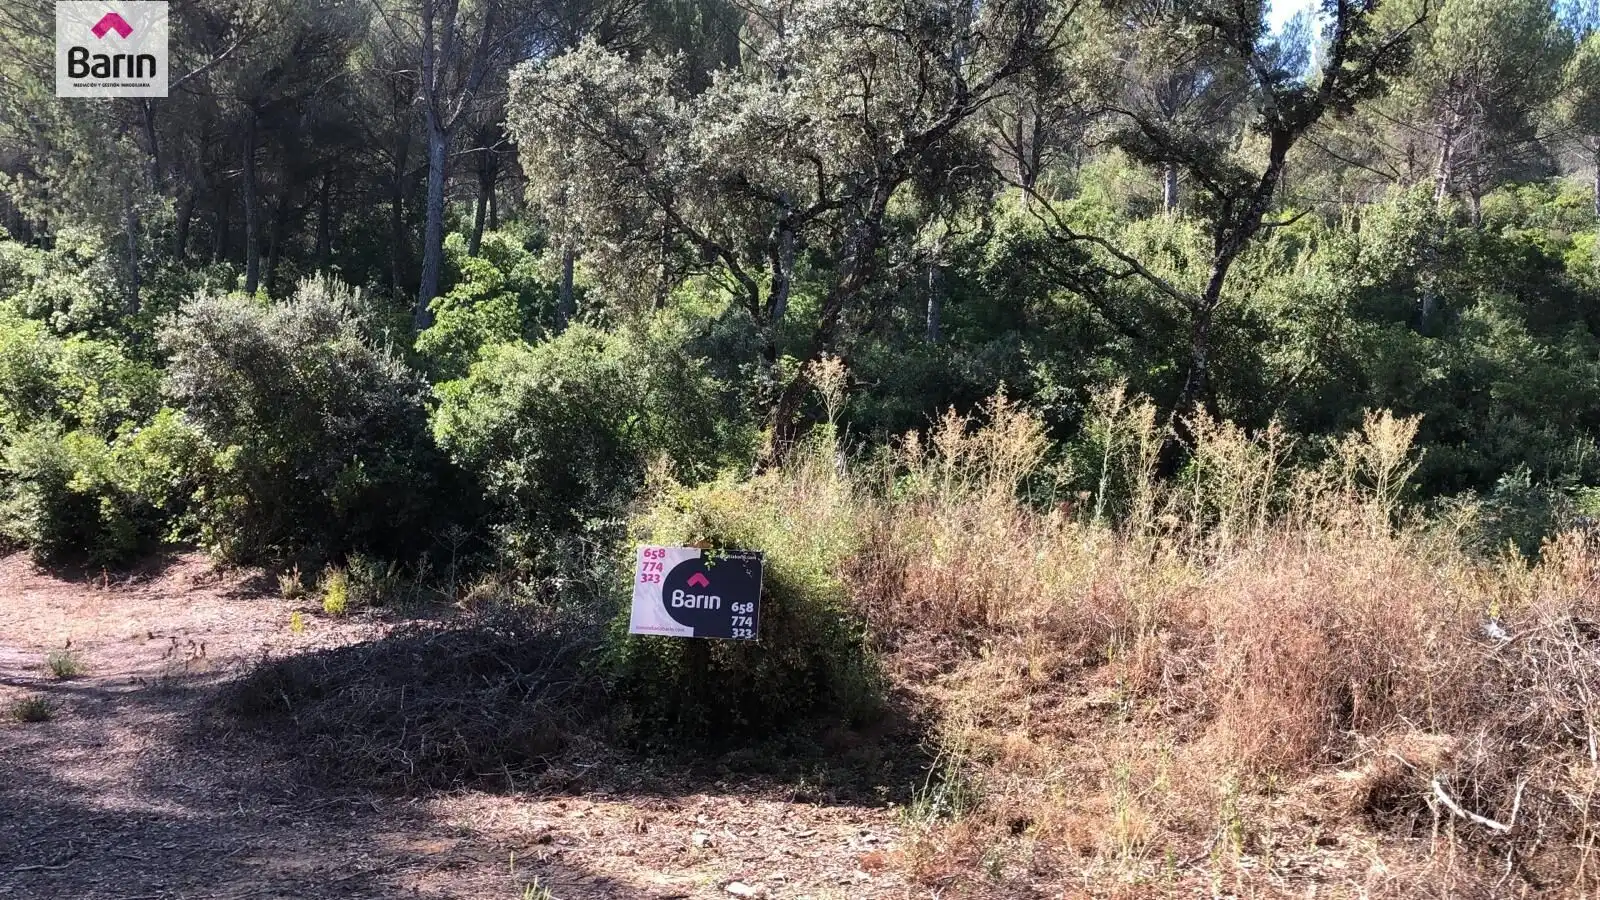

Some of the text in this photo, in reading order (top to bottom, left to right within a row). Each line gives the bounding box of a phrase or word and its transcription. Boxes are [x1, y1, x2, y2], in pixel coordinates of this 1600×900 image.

[643, 548, 666, 560] 658
[641, 561, 664, 572] 774
[640, 573, 661, 584] 323
[671, 589, 721, 610] Barin
[731, 602, 754, 614] 658
[731, 616, 753, 627] 774
[731, 628, 752, 639] 323
